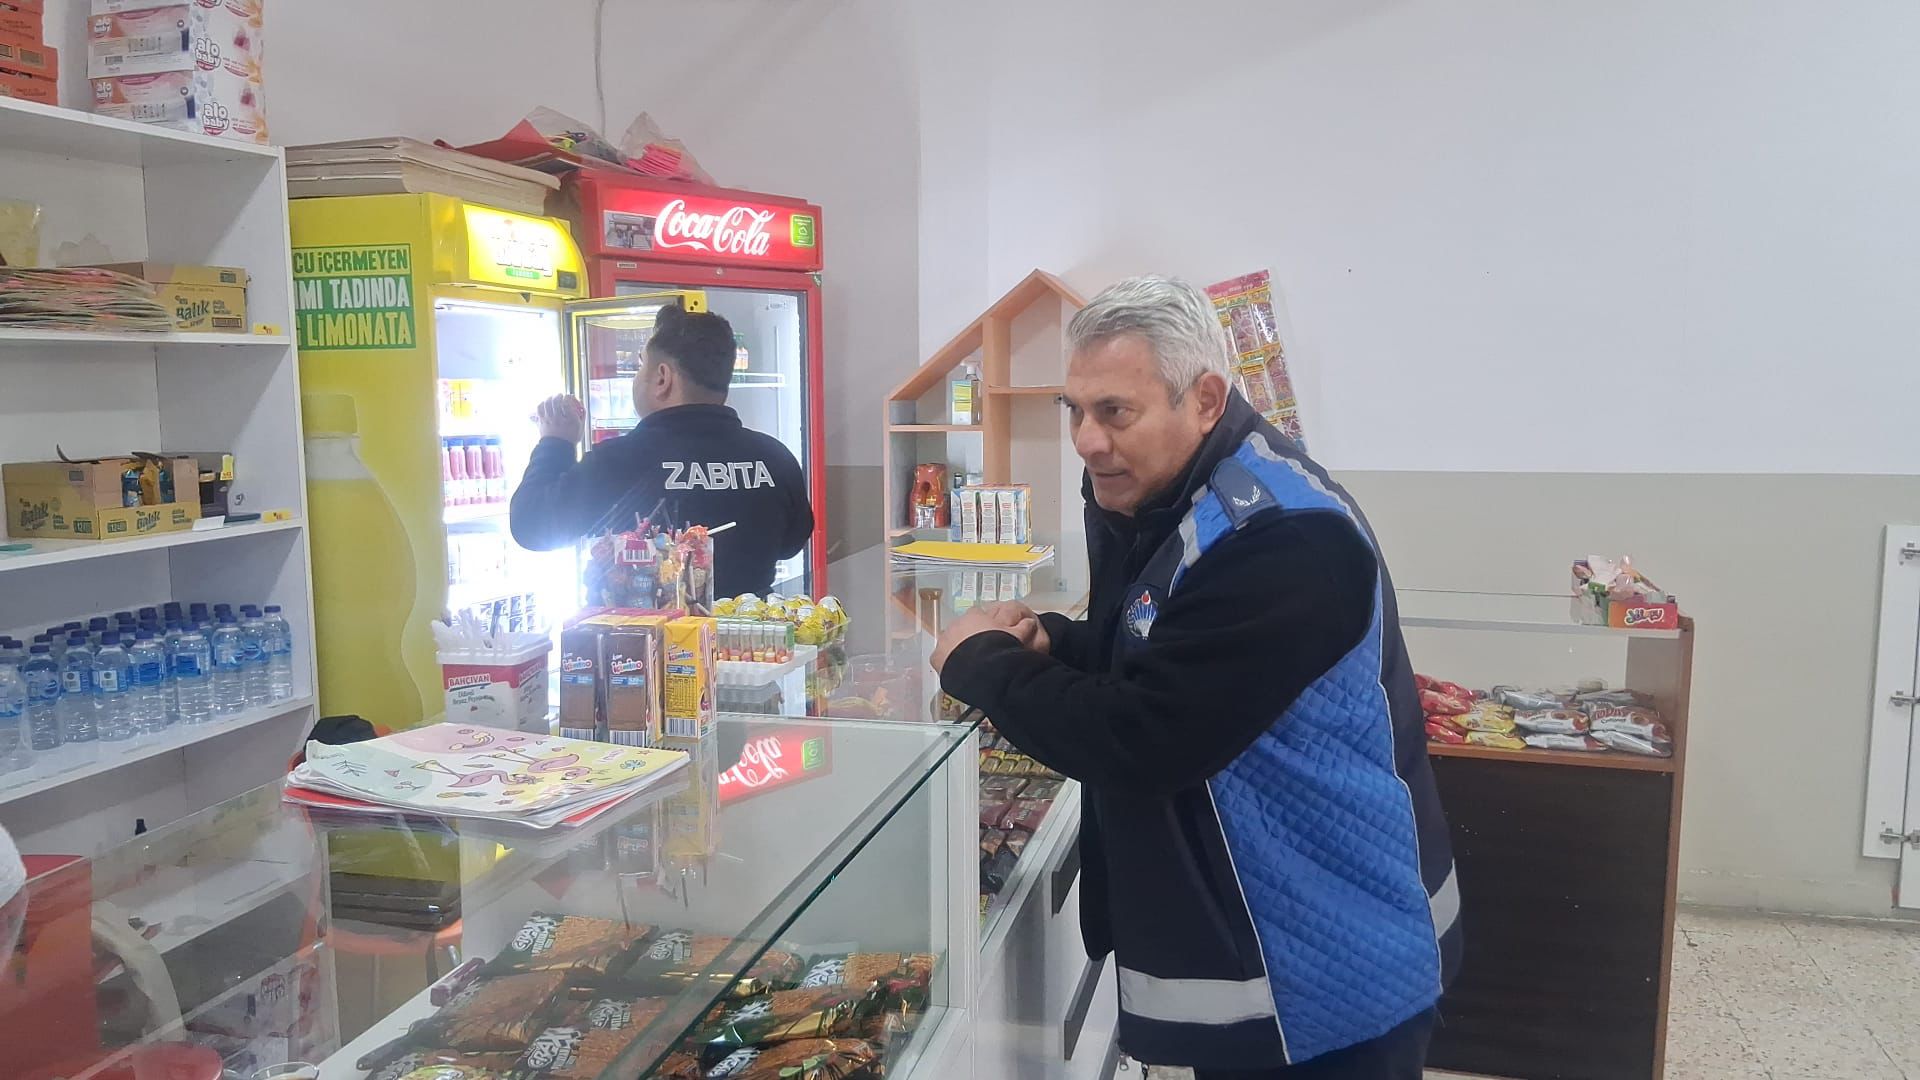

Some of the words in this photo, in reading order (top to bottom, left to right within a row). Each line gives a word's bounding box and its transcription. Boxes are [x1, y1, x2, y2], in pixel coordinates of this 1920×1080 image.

[196, 38, 220, 55] alo
[195, 52, 221, 69] baby
[203, 102, 228, 119] alo
[203, 116, 229, 132] baby
[655, 199, 776, 257] Coca-Cola
[329, 276, 410, 310] TADINDA
[662, 460, 776, 490] ZABITA
